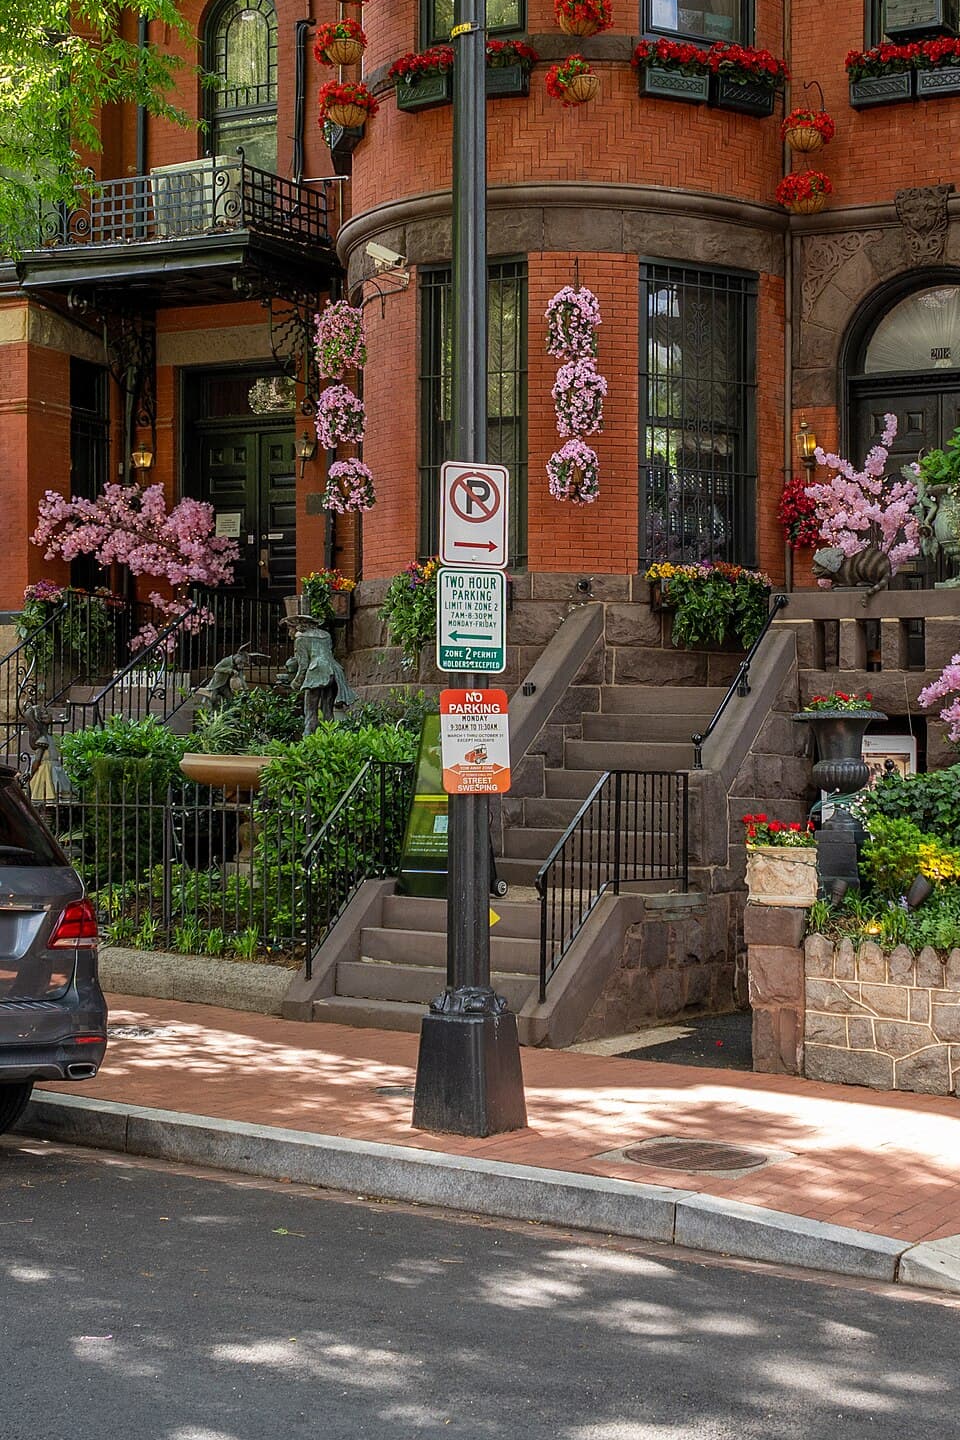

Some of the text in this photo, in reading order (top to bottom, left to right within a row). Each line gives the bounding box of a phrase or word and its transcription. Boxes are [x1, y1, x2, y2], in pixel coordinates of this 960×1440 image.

[445, 576, 496, 589] TWO HOUR
[452, 590, 492, 601] PARKING
[445, 601, 462, 610] LIMIT
[465, 602, 471, 610] IN
[474, 602, 494, 611] ZONE
[448, 620, 497, 628] MONDAY-FRIDAY
[465, 647, 471, 660] 2
[442, 660, 470, 668] HOLDERS
[465, 692, 483, 702] NO
[449, 703, 500, 713] PARKING
[457, 784, 498, 792] SWEEPING
